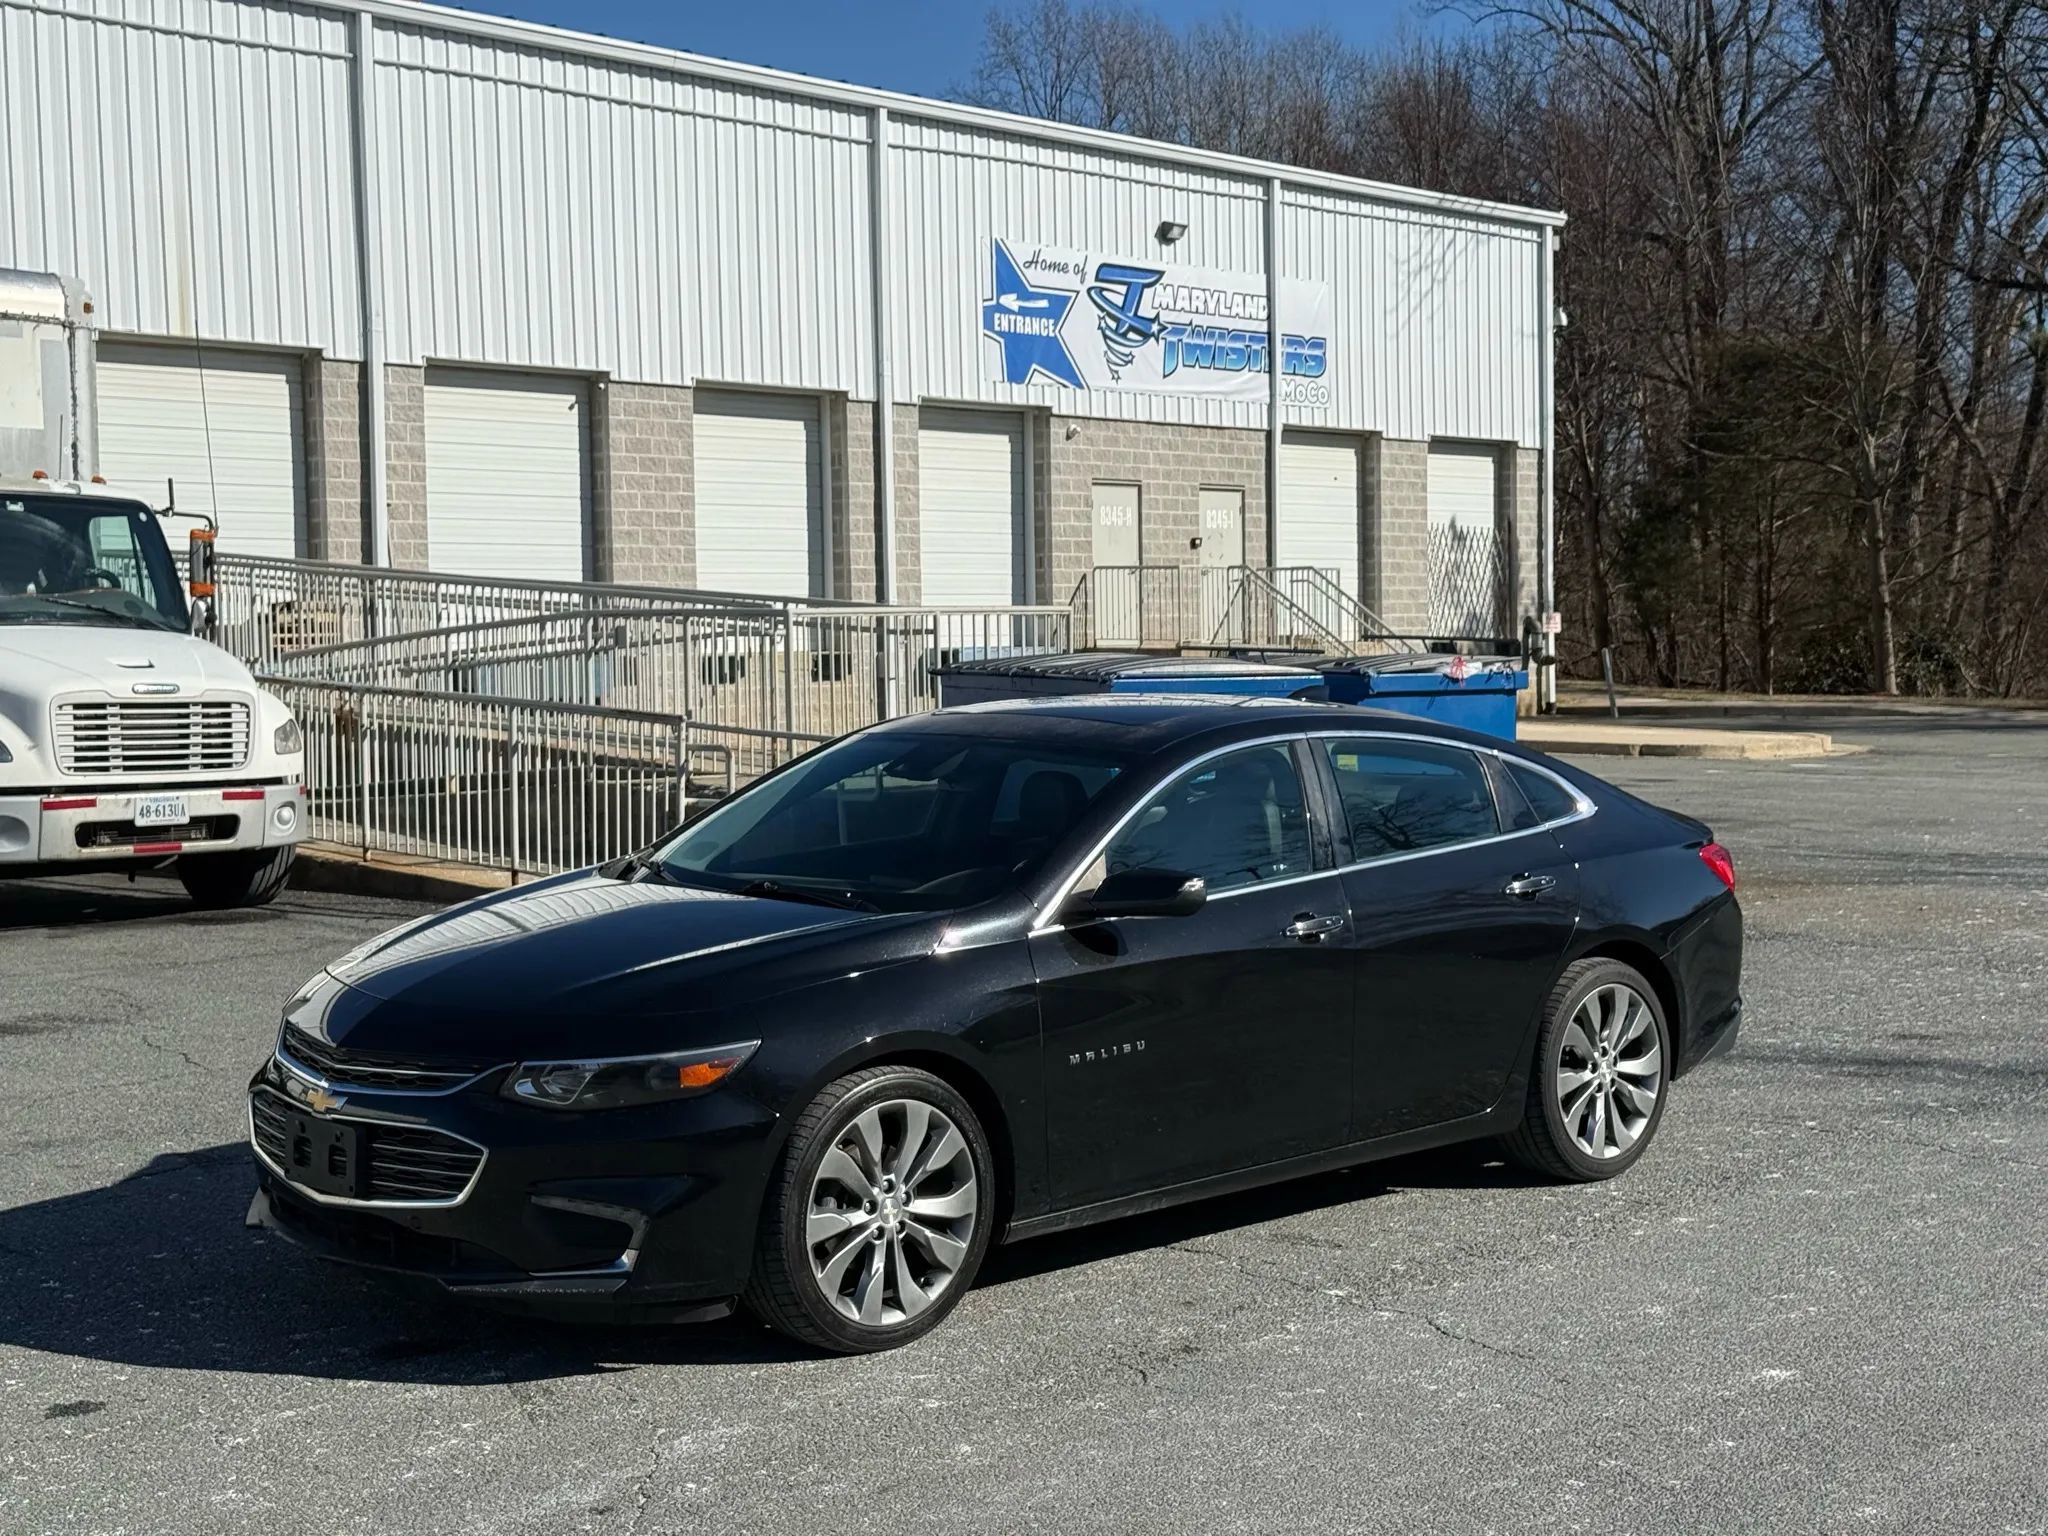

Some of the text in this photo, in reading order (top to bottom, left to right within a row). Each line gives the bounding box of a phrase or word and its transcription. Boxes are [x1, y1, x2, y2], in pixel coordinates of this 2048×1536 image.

[1023, 248, 1088, 284] Home of
[1152, 284, 1270, 321] MARYLAND
[994, 312, 1055, 337] ENTRANCE
[1161, 320, 1327, 379] TWISTRS
[1281, 379, 1330, 405] MoCo
[139, 803, 186, 818] 48-613UA
[1069, 1040, 1146, 1065] MALIBU
